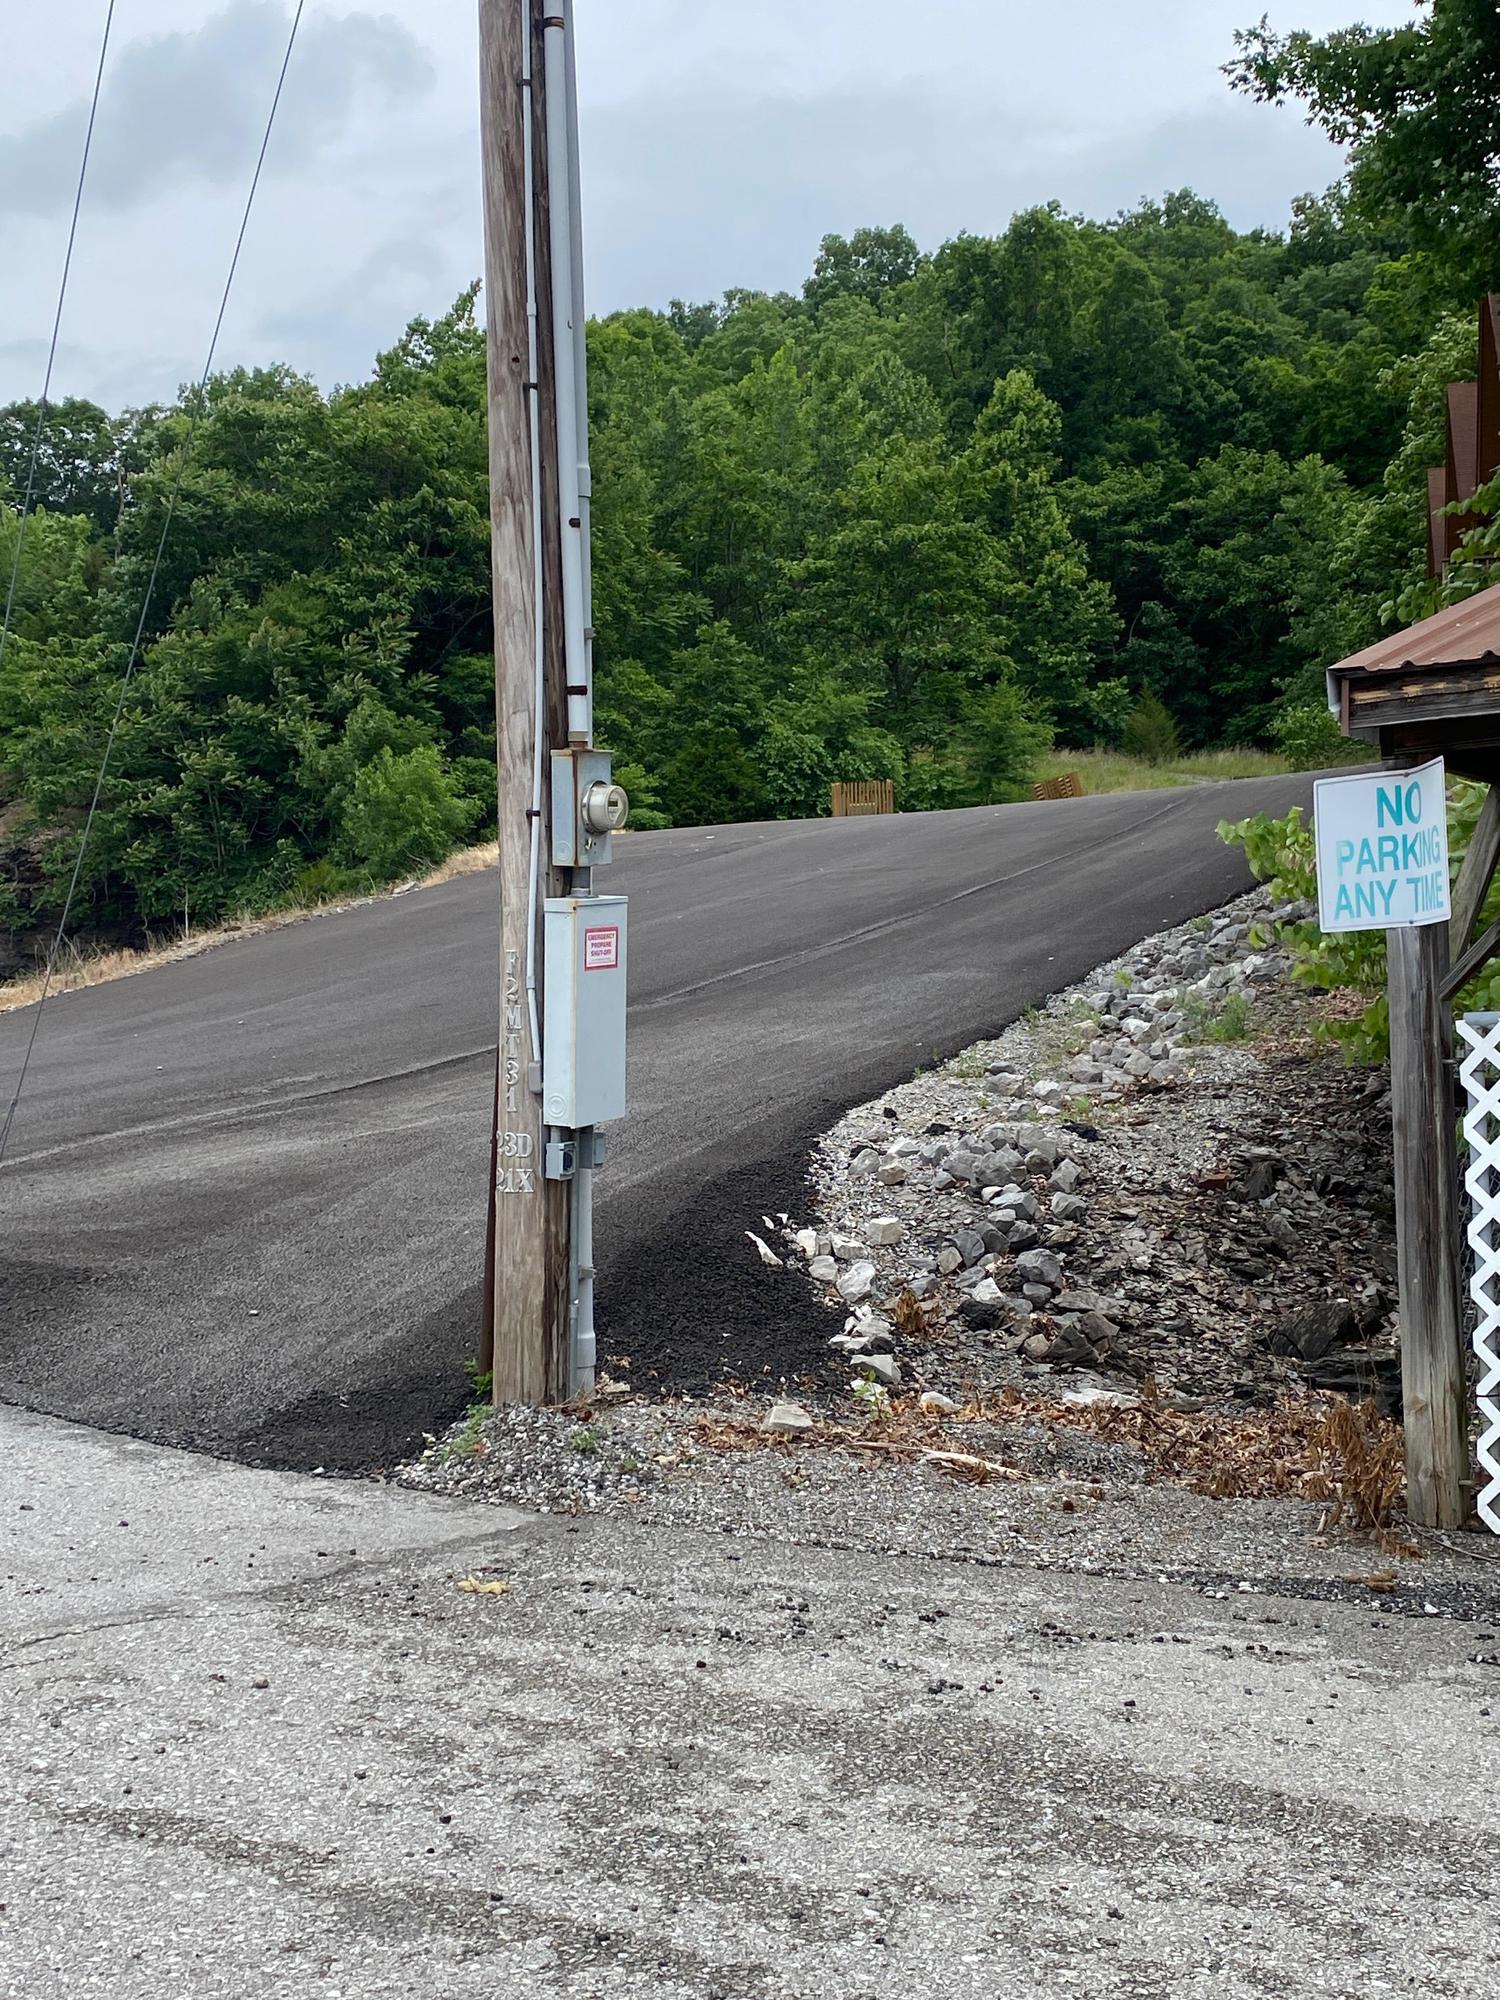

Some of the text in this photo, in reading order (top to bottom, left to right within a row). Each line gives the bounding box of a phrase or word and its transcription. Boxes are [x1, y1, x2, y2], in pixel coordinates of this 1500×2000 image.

[1376, 781, 1422, 828] NO
[1336, 825, 1440, 876] PARKING
[1334, 870, 1444, 922] ANY TIME
[588, 933, 614, 941] EMERGENCY
